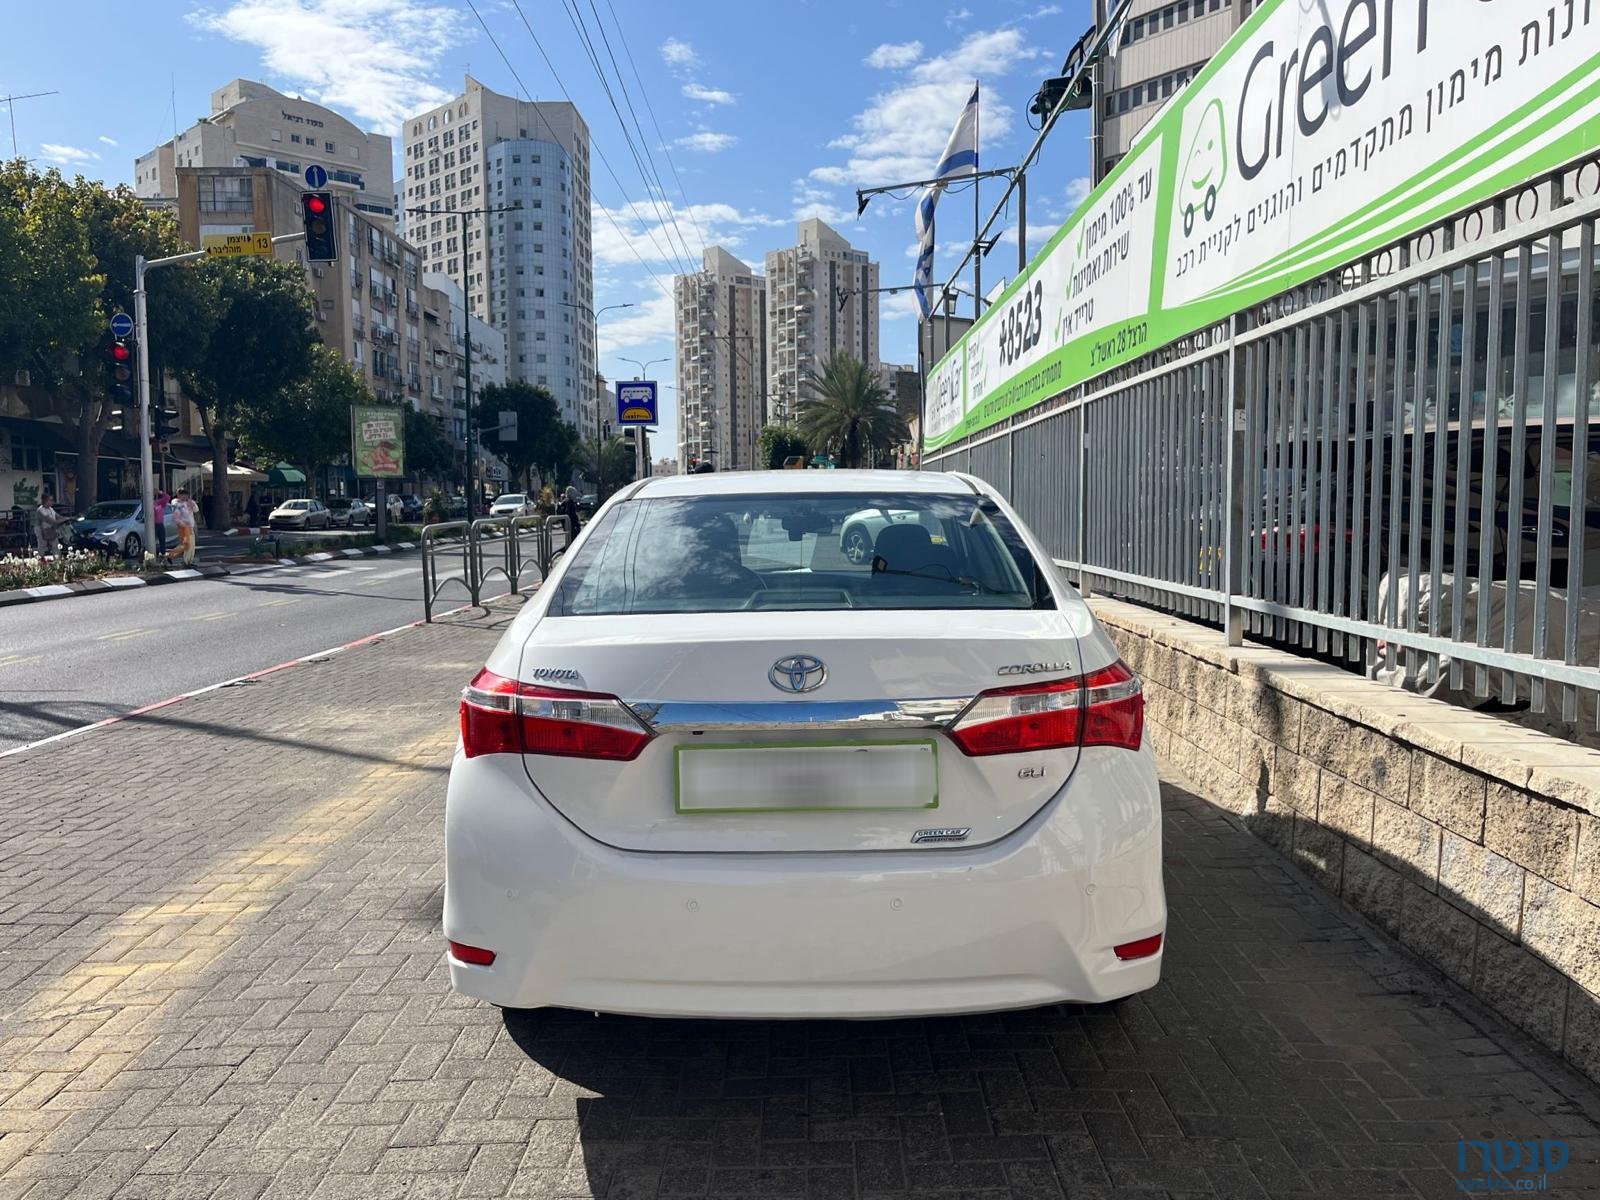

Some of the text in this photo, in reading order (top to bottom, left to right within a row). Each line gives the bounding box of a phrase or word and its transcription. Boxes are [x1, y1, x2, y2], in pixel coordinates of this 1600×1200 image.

[1426, 44, 1503, 133] מימון
[1312, 103, 1413, 194] מתקדמים
[1085, 167, 1152, 260] עד 100% מימון
[1247, 176, 1302, 234] והוגנים
[257, 238, 268, 249] 13
[1199, 215, 1241, 265] לקניית
[1072, 230, 1130, 298] שירות ואמינות
[1176, 248, 1196, 278] רכב
[1062, 298, 1094, 347] טרייד אין
[1127, 320, 1148, 350] הרצל
[1116, 329, 1126, 355] 28
[532, 666, 580, 680] TOYOTA
[997, 661, 1072, 676] COROLLA
[1017, 766, 1046, 780] GLI
[918, 829, 944, 837] GREEN
